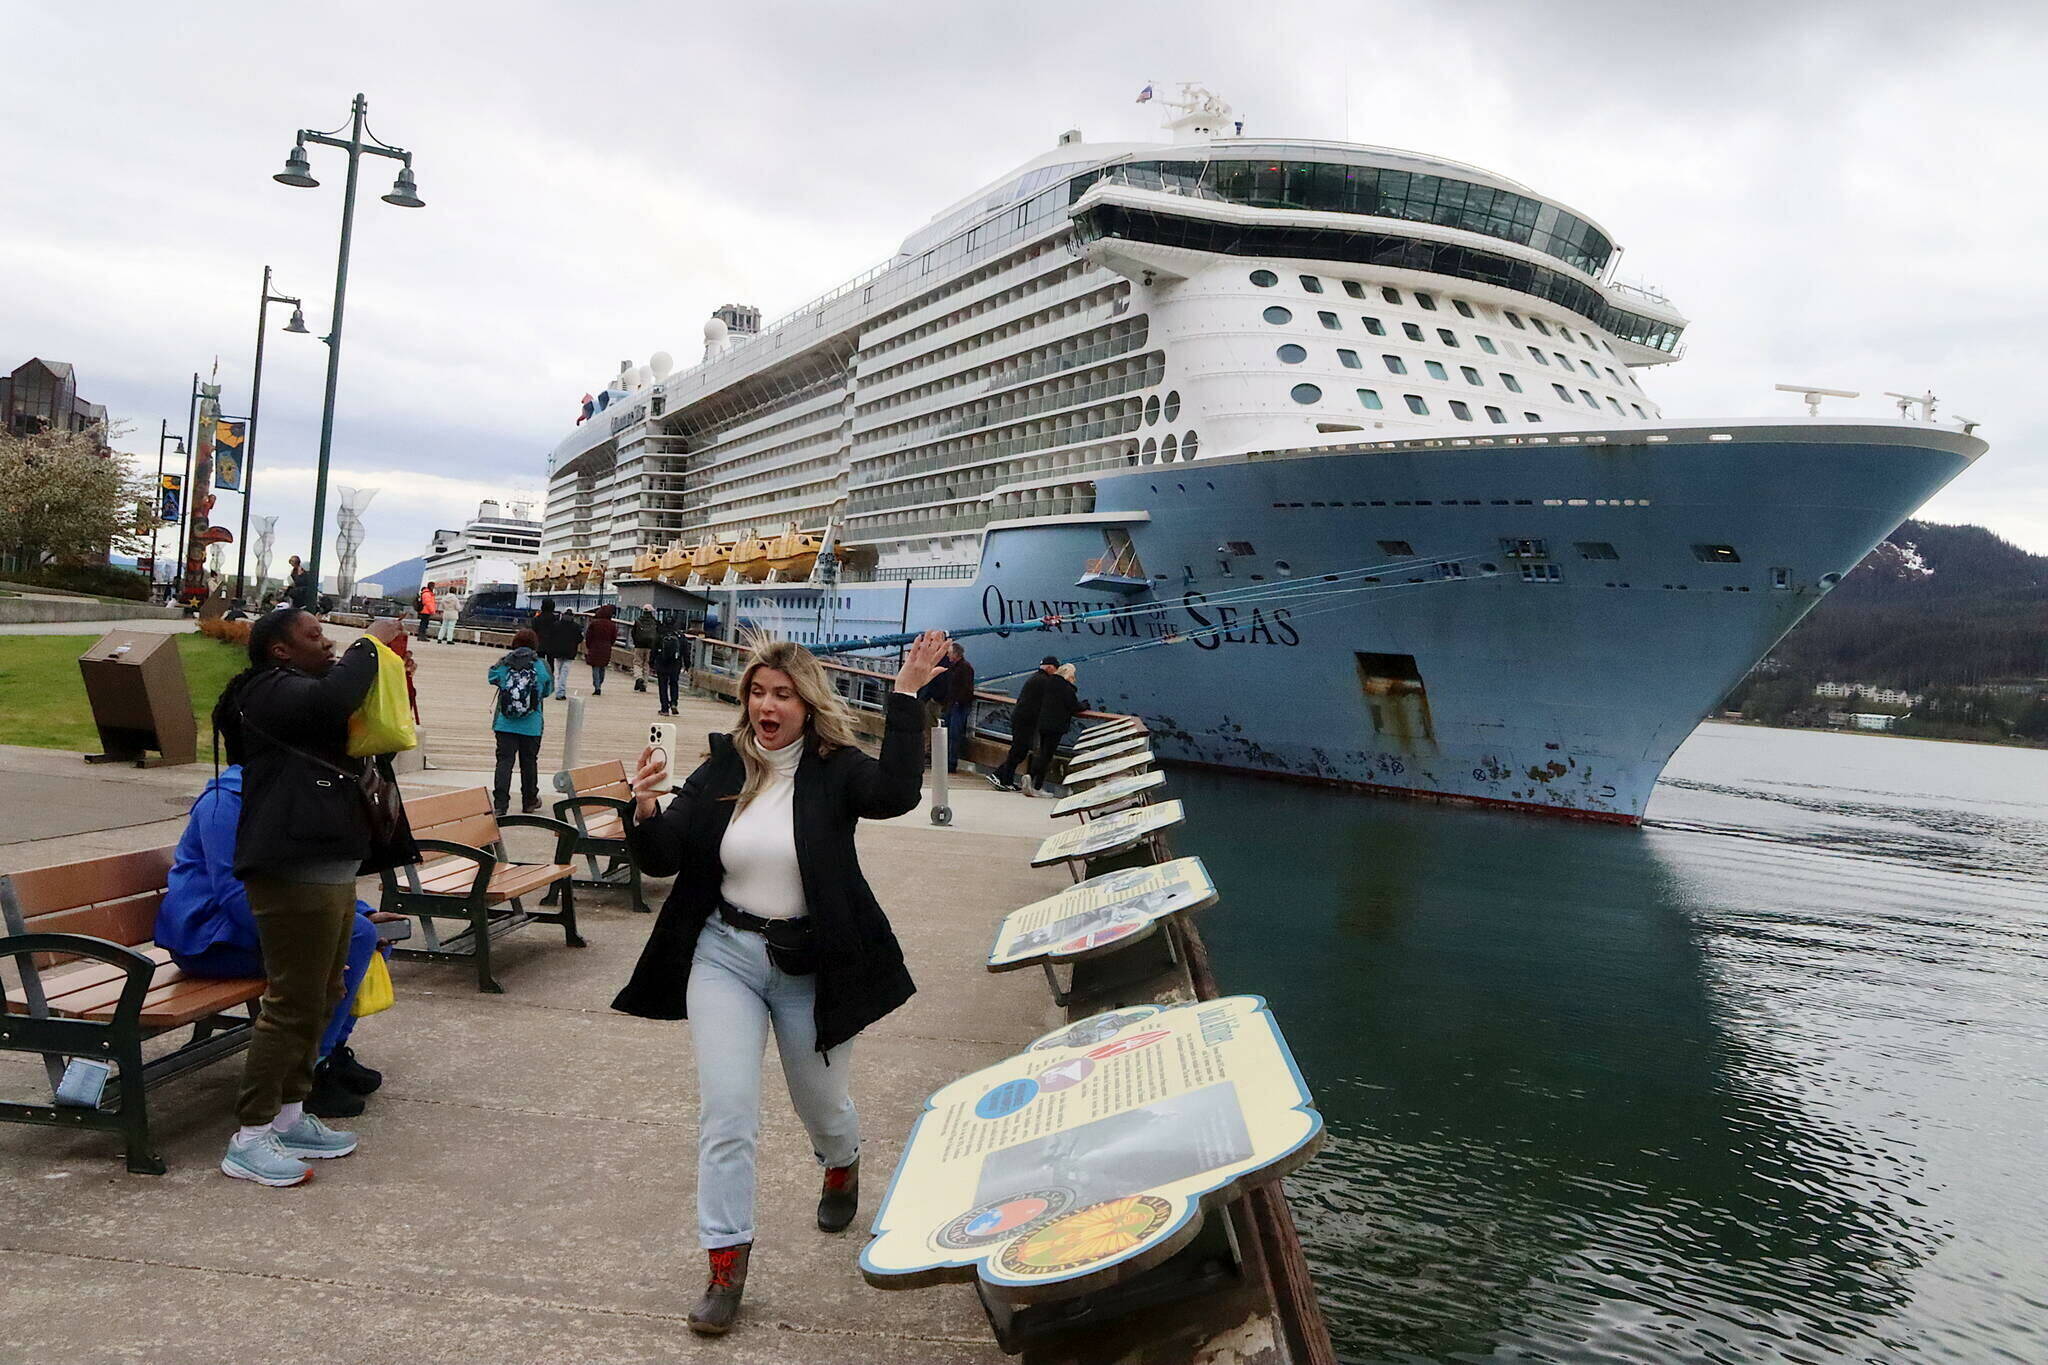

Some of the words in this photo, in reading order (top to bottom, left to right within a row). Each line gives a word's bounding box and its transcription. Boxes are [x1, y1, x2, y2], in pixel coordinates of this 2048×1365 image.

[982, 584, 1141, 639] QUANTUM
[1147, 604, 1168, 620] OF
[1183, 590, 1300, 651] SEAS
[1145, 621, 1179, 639] THE
